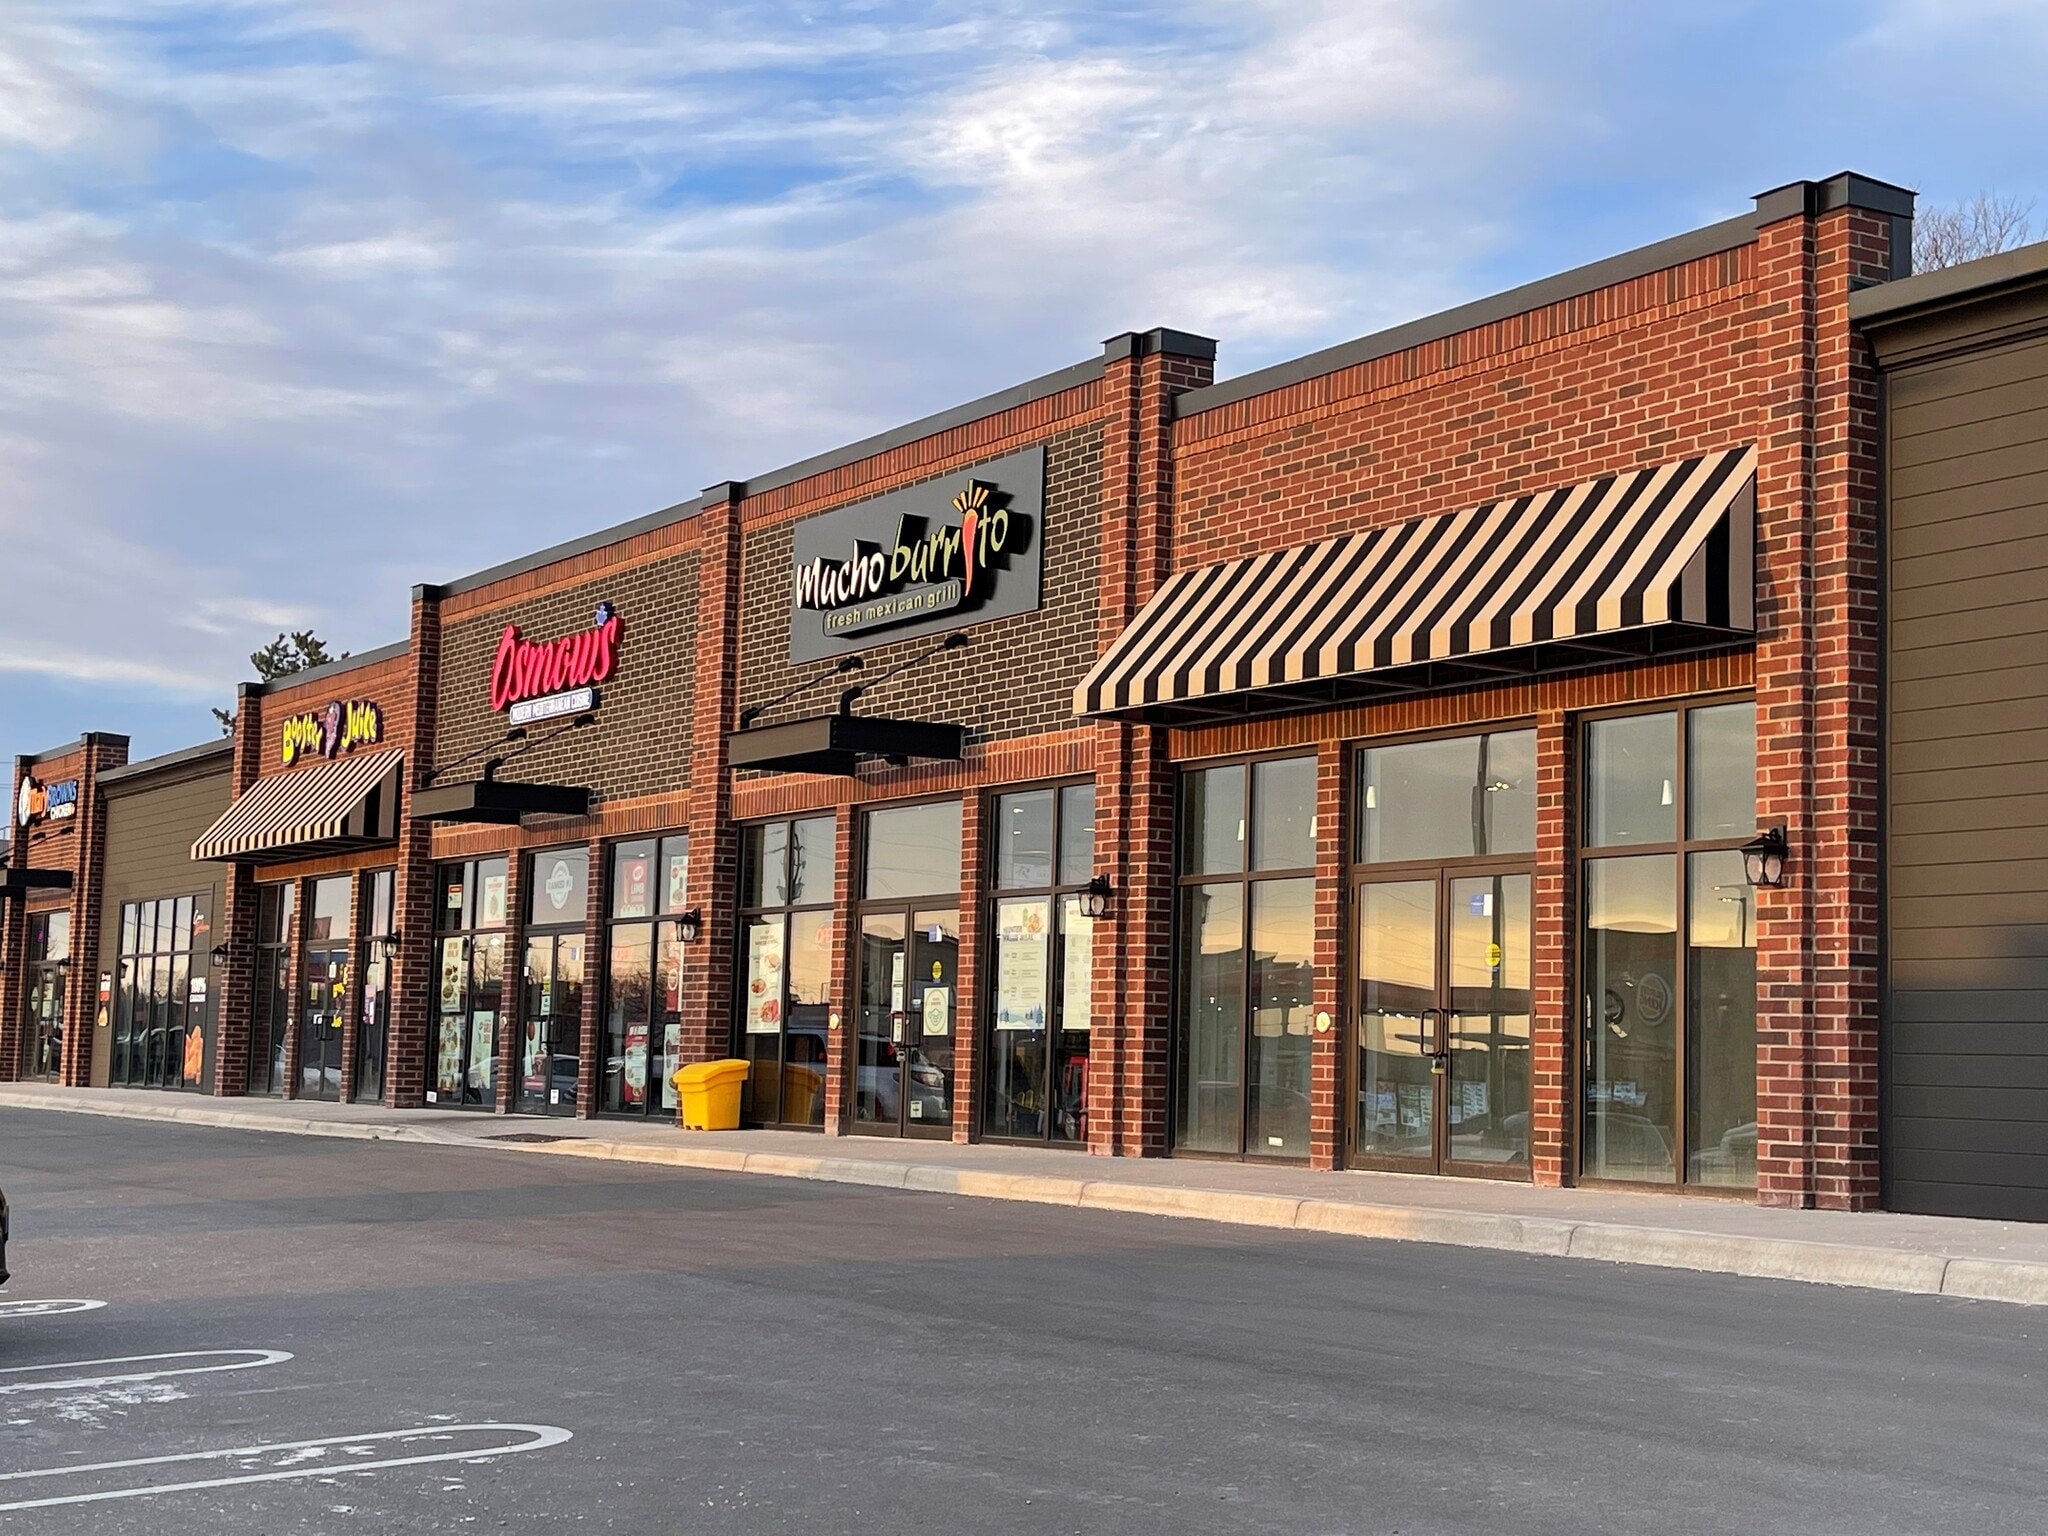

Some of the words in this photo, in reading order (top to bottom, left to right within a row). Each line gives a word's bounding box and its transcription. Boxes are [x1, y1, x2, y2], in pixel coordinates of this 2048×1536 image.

[826, 608, 861, 630] fresh
[866, 594, 924, 621] mexican
[927, 583, 958, 610] grill
[282, 712, 323, 766] Booster
[341, 700, 378, 750] Juice
